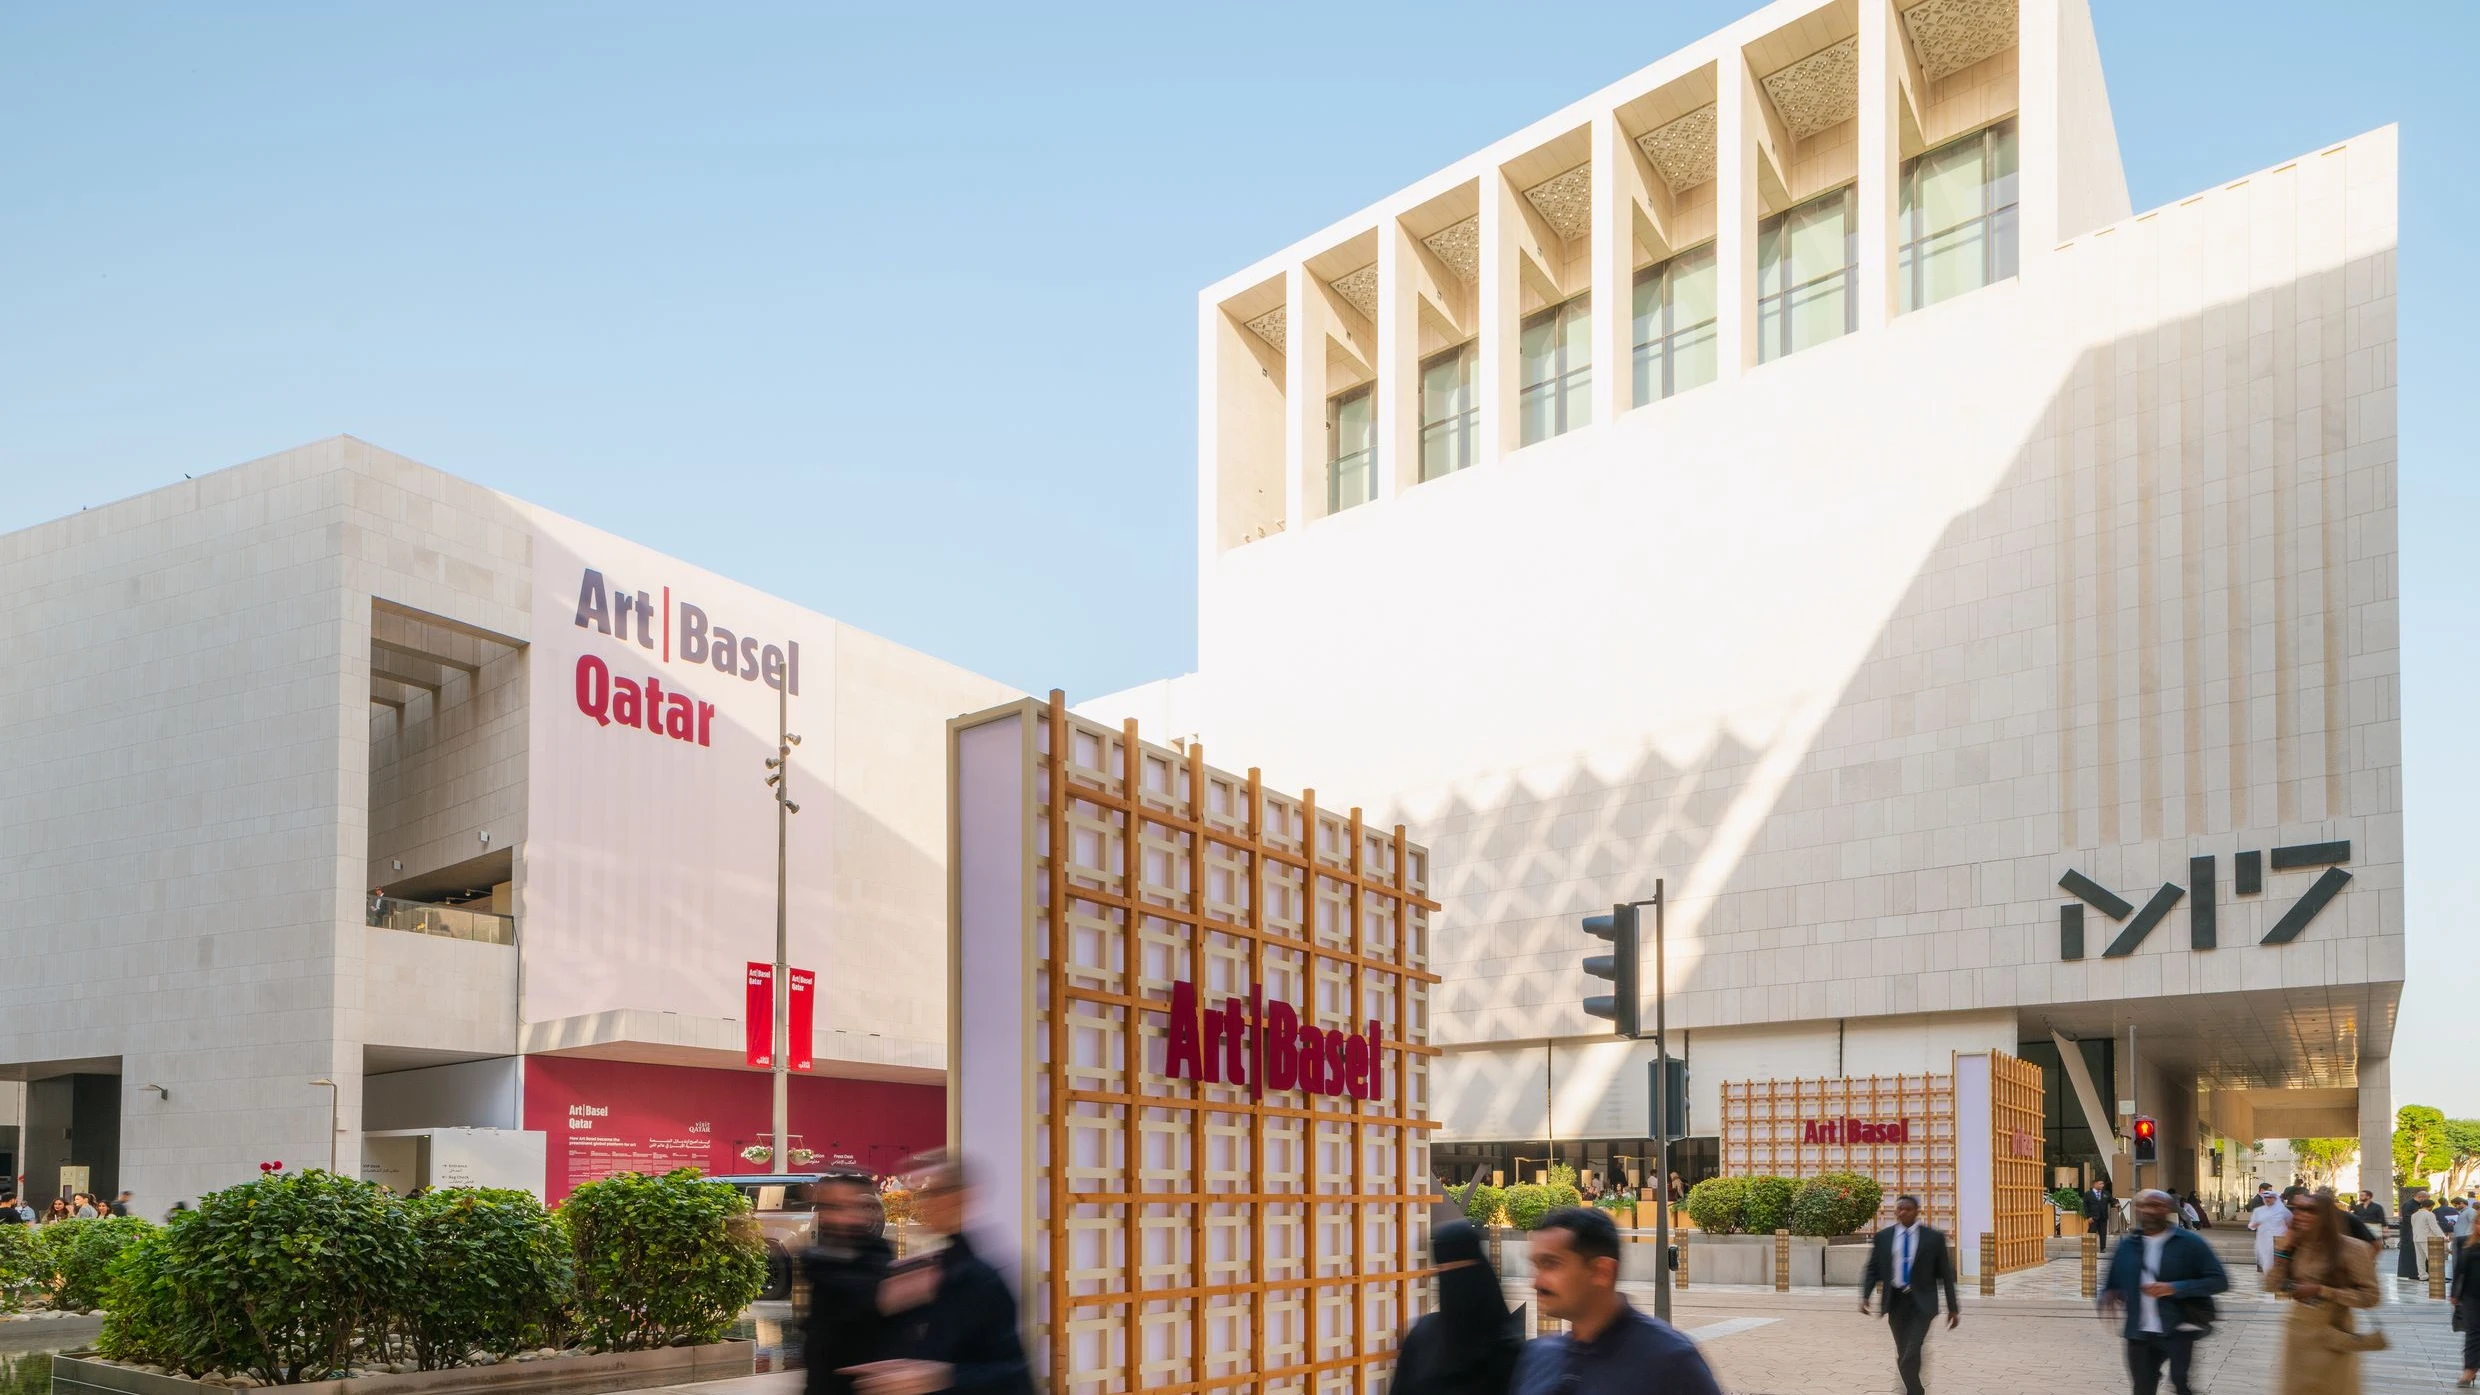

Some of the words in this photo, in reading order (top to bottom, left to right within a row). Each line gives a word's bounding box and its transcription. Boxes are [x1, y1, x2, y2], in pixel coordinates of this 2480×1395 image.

[575, 568, 654, 650] Art
[680, 601, 799, 697] Basel
[575, 654, 715, 748] Qatar
[1165, 980, 1245, 1085] Art
[1268, 999, 1382, 1101] Basel
[569, 1105, 582, 1116] Art
[585, 1105, 608, 1117] Basel
[569, 1118, 593, 1130] Qatar
[1804, 1119, 1837, 1145] Art
[1847, 1118, 1910, 1145] Basel
